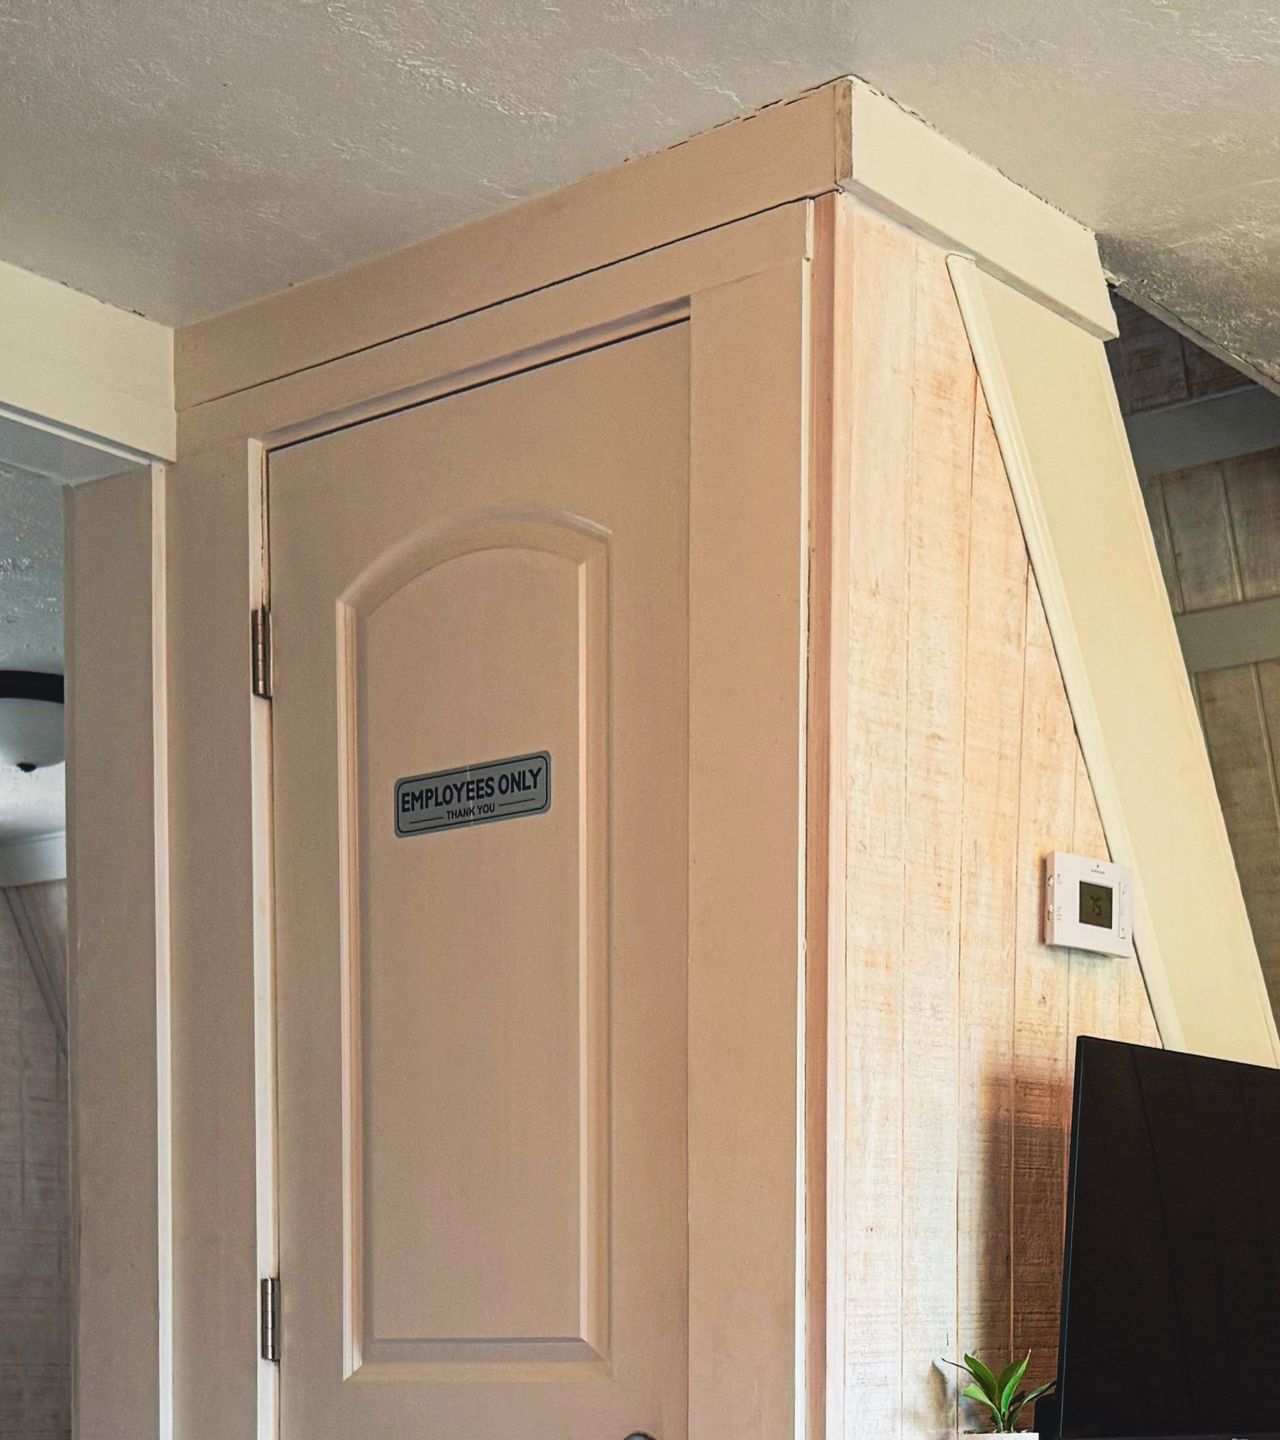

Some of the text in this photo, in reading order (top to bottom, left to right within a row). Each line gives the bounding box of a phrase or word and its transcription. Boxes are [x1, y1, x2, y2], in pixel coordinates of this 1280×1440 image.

[401, 766, 543, 813] EMPLOYEES ONLY
[446, 803, 496, 820] THANK YOU
